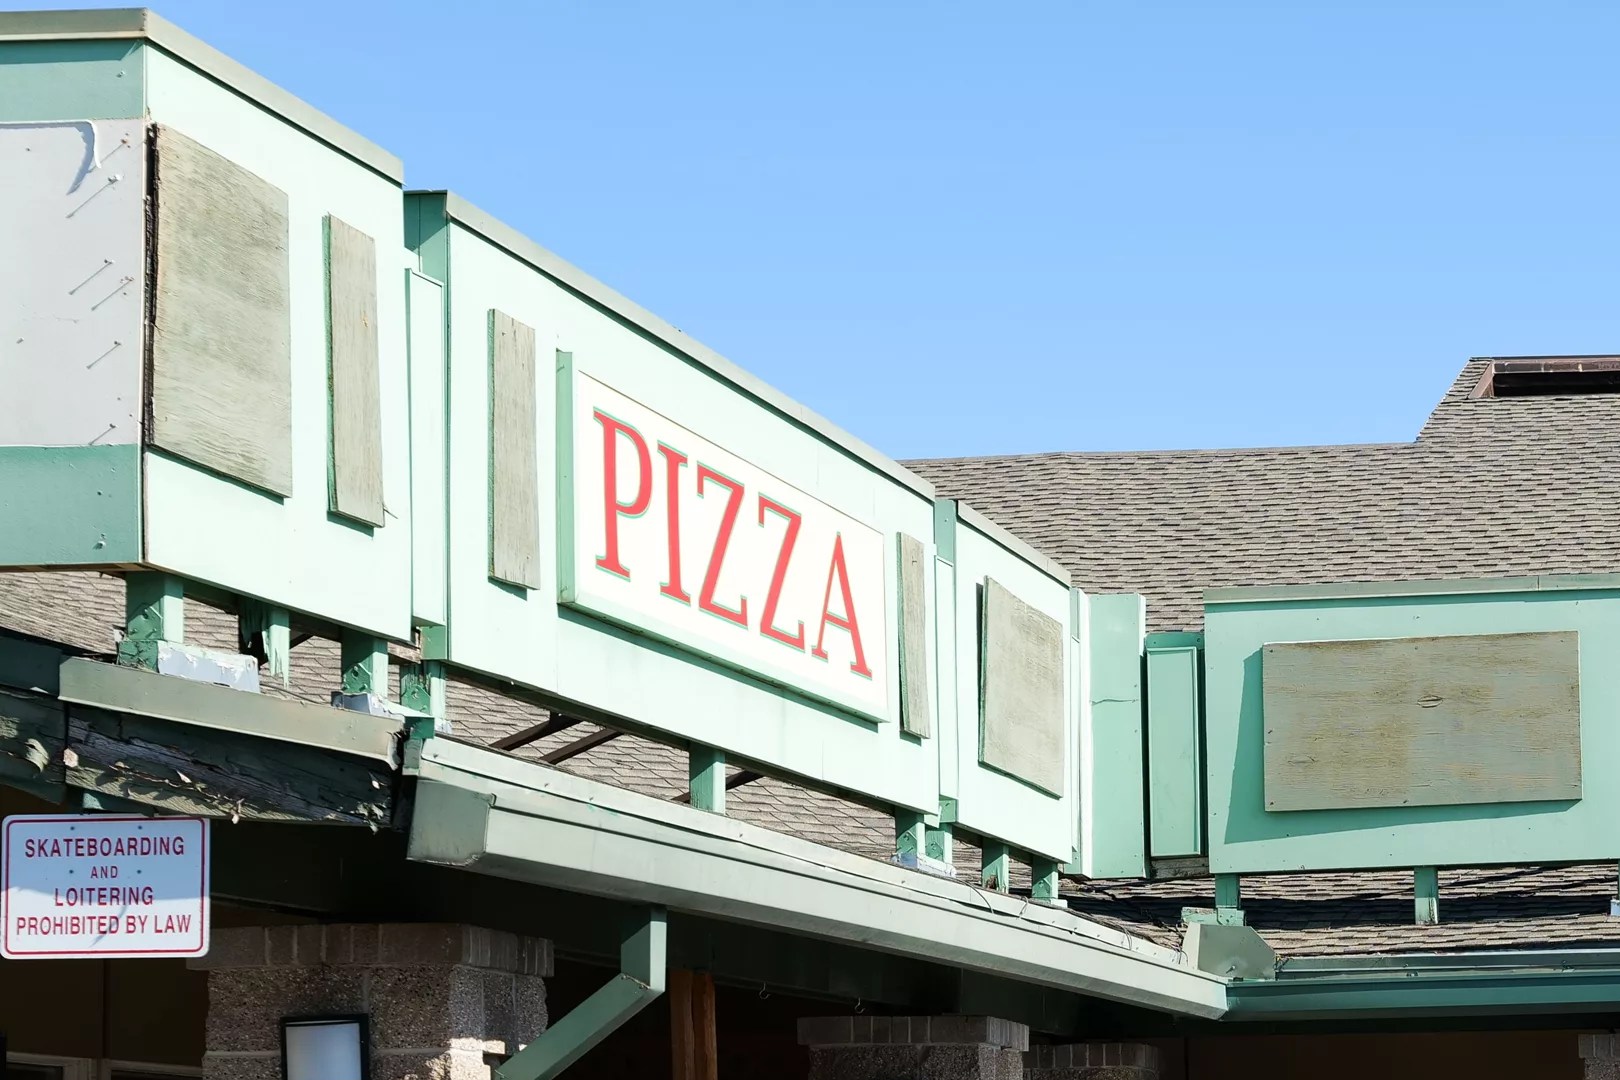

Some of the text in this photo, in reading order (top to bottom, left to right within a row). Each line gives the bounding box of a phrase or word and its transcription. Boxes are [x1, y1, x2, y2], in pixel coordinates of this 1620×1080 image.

[594, 407, 873, 680] PIZZA
[25, 836, 184, 858] SKATEBOARDING
[91, 866, 118, 878] AND
[54, 886, 153, 907] LOITERING
[16, 914, 191, 936] PROHIBITED BY LAW
